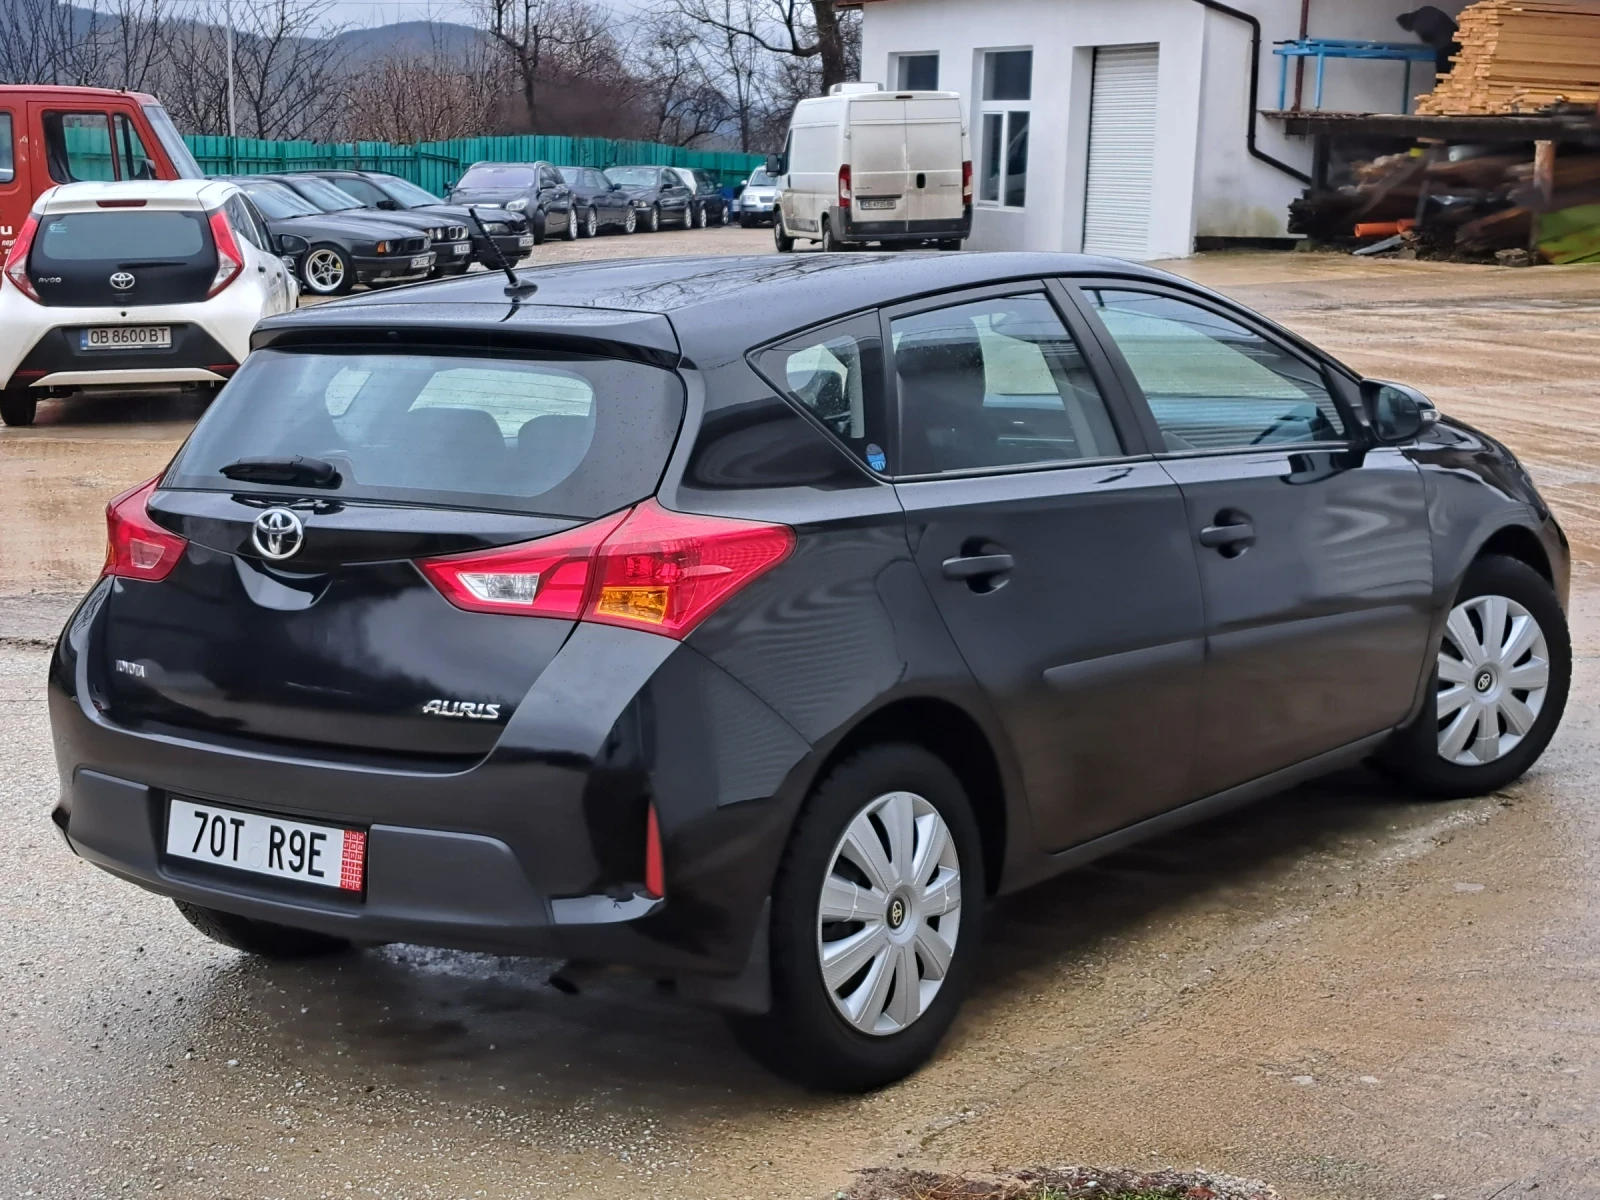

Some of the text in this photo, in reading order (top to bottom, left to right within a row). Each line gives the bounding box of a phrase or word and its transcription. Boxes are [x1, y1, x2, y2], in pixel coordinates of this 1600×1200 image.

[90, 328, 168, 344] OB 8600 BT
[422, 699, 501, 719] AURIS
[192, 810, 327, 877] 70T R9E
